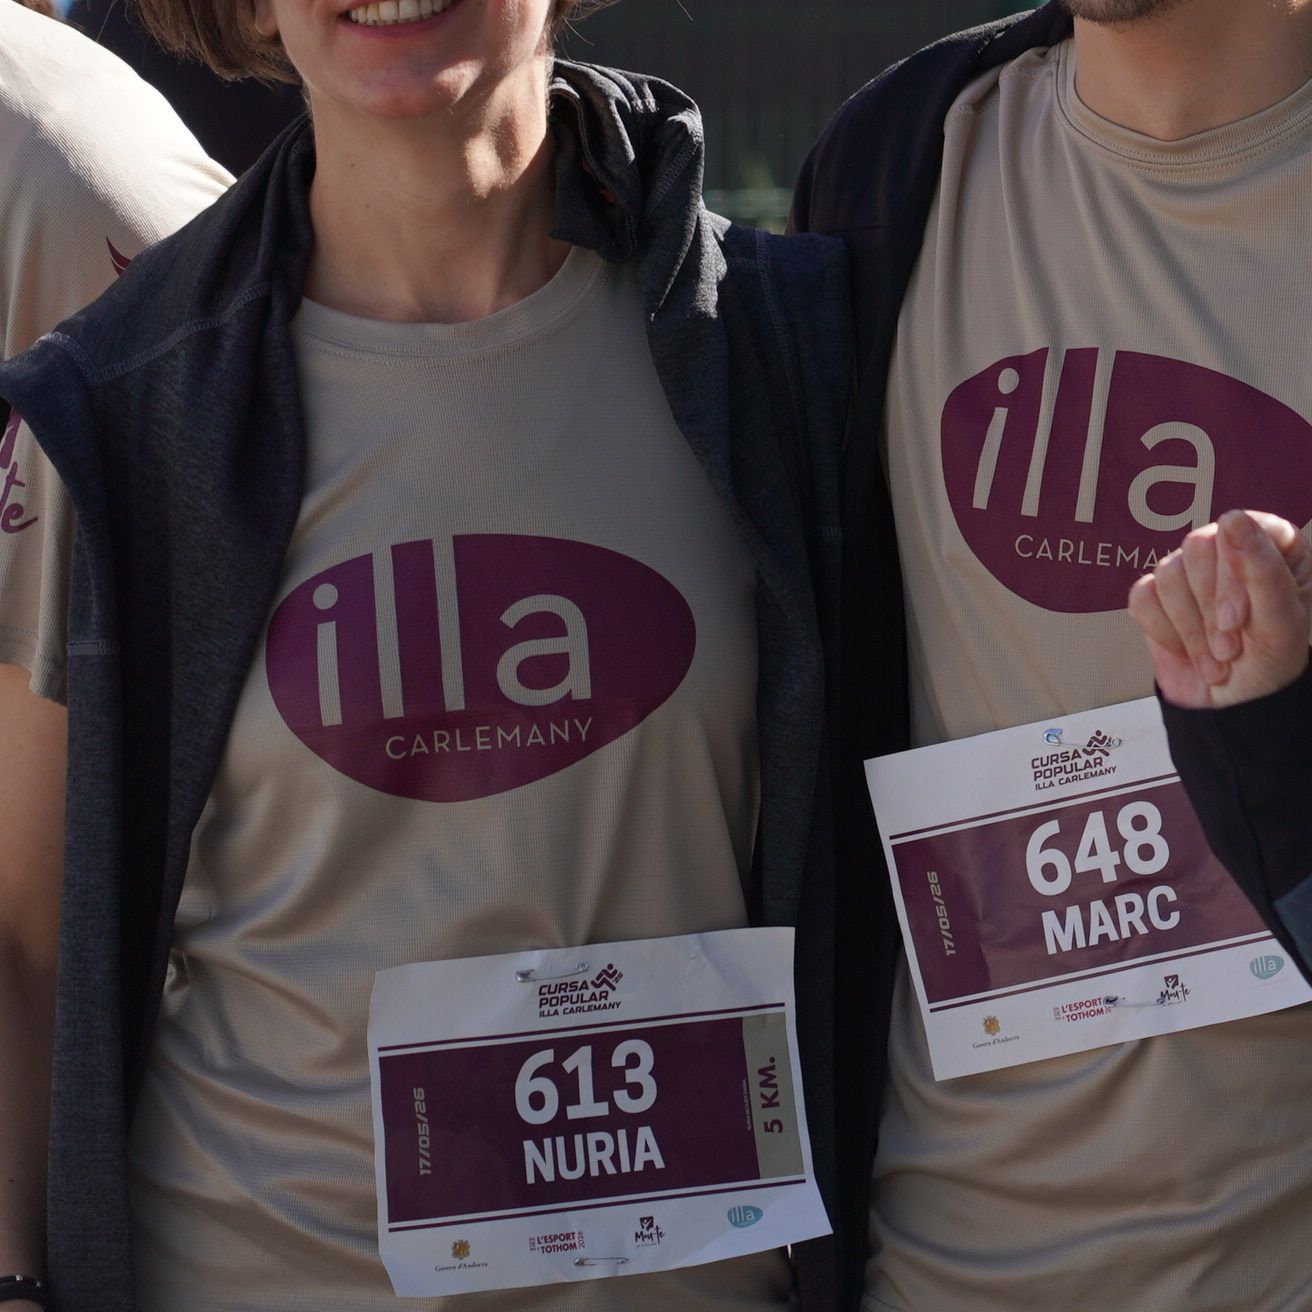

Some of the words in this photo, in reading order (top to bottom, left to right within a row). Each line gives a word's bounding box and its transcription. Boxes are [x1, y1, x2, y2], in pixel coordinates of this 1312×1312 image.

[972, 347, 1215, 532] illa
[0, 462, 38, 533] te
[1015, 534, 1174, 570] CARLEMA
[313, 531, 592, 728] illa
[385, 717, 593, 760] CARLEMANY
[1031, 748, 1081, 769] CURSA
[1034, 756, 1103, 781] POPULAR
[1035, 781, 1055, 791] ILLA
[1058, 765, 1117, 786] CARLEMANY
[1025, 801, 1170, 896] 648
[926, 871, 956, 956] 17/05/26
[1041, 885, 1180, 955] MARC
[538, 979, 589, 997] CURSA
[539, 990, 609, 1009] POPULAR
[1062, 997, 1103, 1013] L'ESPORT
[539, 1010, 559, 1018] ILLA
[562, 1001, 621, 1016] CARLEMANY
[1066, 1008, 1104, 1023] TOTHOM
[515, 1039, 657, 1125] 613
[758, 1056, 780, 1109] KM.
[413, 1087, 432, 1176] 17/05/26
[763, 1118, 784, 1134] 5
[522, 1126, 665, 1185] NURIA
[537, 1231, 576, 1245] L'ESPORT
[541, 1242, 577, 1254] TOTHOM
